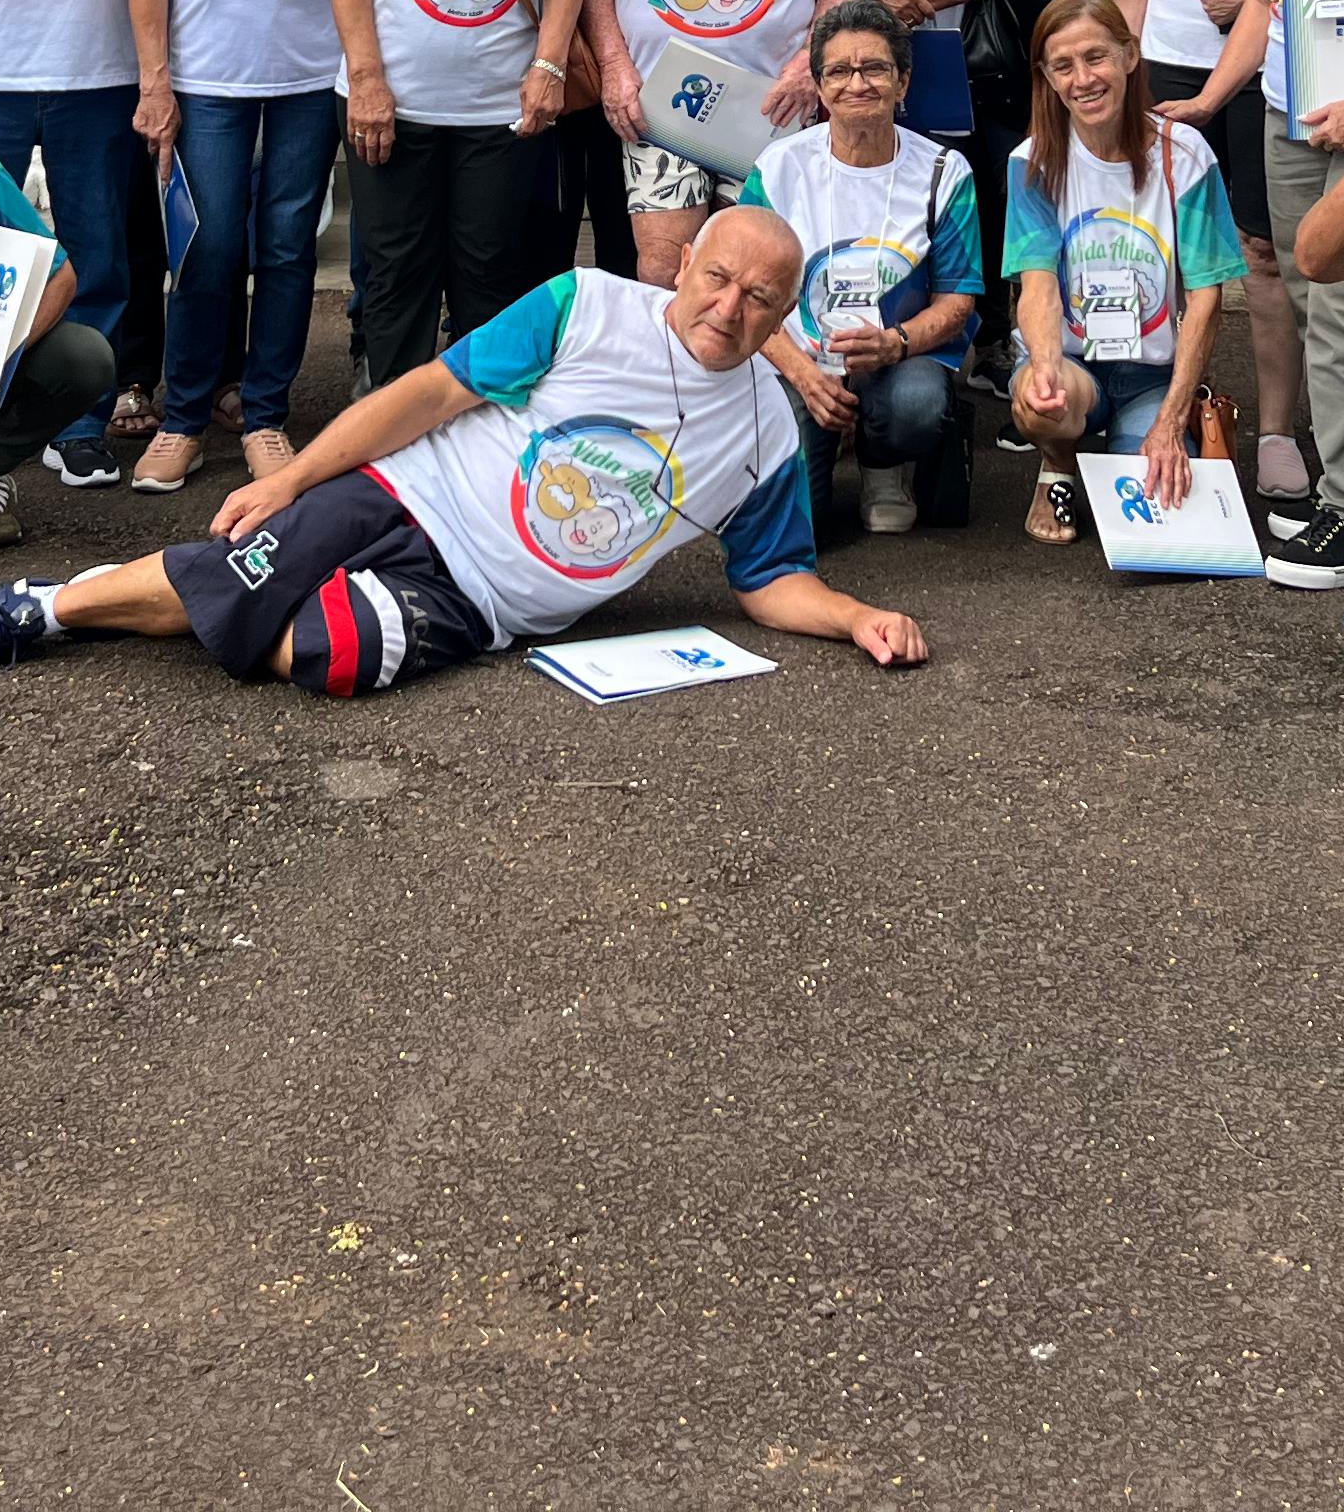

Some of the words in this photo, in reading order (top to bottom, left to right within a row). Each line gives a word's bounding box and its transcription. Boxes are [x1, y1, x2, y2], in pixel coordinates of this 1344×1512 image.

[671, 73, 713, 119] 20
[697, 81, 726, 124] ESCOLA
[569, 438, 622, 475] Vida
[1115, 475, 1154, 524] 20
